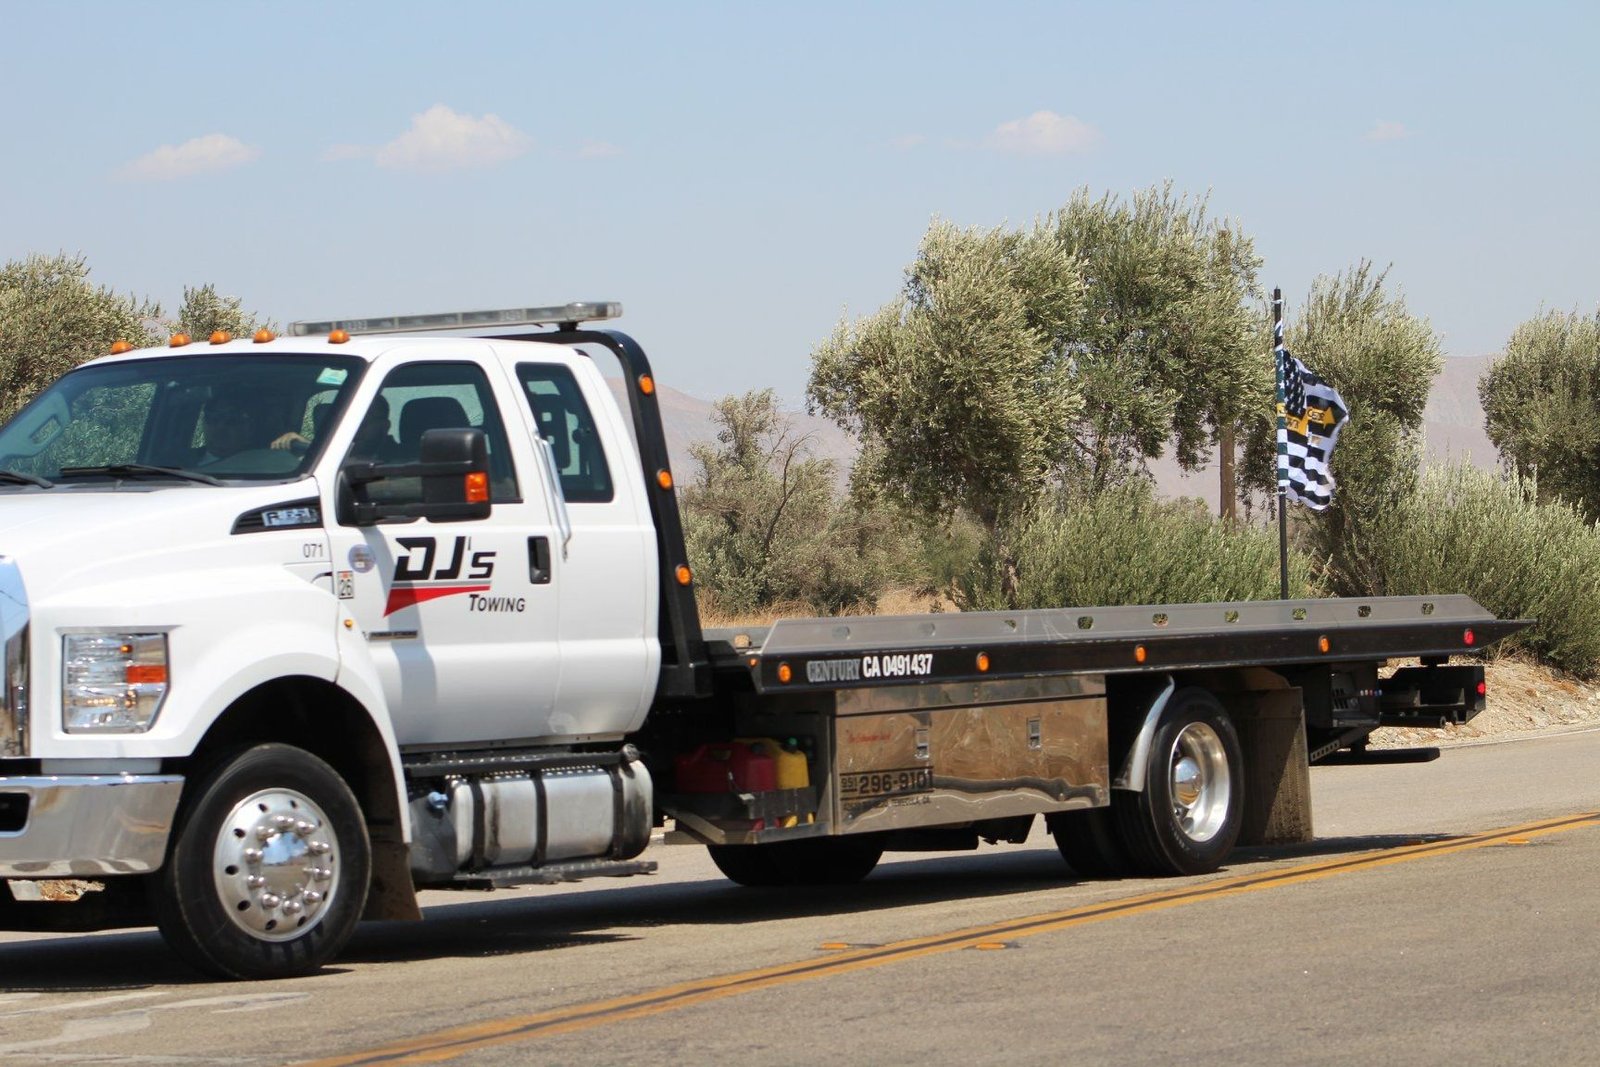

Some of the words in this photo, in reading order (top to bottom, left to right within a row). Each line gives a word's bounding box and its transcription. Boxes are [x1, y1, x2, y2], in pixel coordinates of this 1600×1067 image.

[303, 543, 323, 558] 071
[339, 578, 354, 596] 26
[807, 659, 860, 682] CENTURY
[862, 656, 881, 678] CA
[882, 654, 933, 677] 0491437
[859, 770, 933, 794] 296-9101
